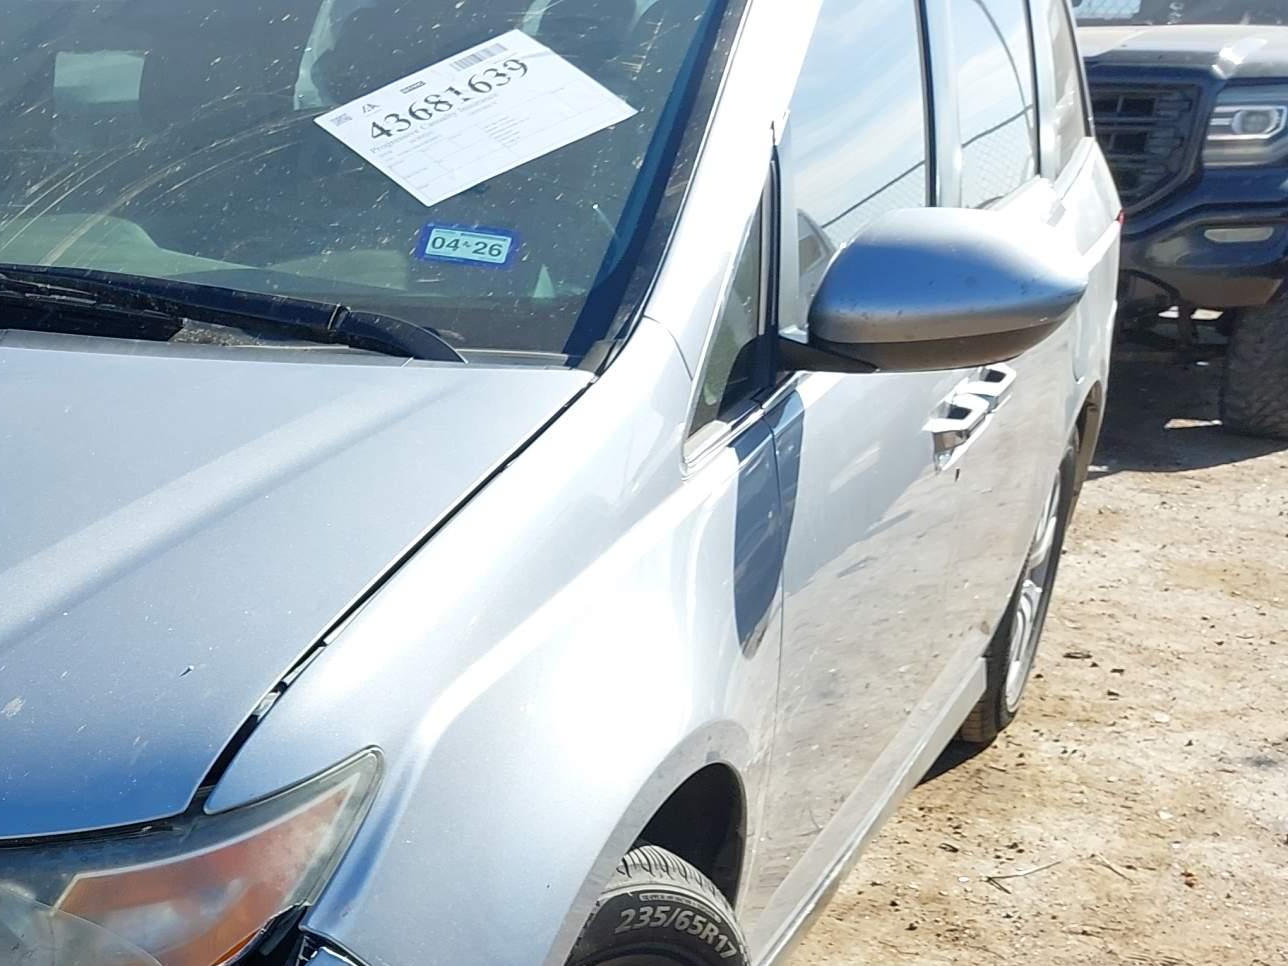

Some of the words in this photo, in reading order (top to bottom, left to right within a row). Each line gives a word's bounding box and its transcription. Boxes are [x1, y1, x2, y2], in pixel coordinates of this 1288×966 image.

[371, 59, 528, 139] 43681639
[431, 236, 461, 252] 04
[472, 241, 504, 257] 26
[614, 905, 738, 959] 235/65R17
